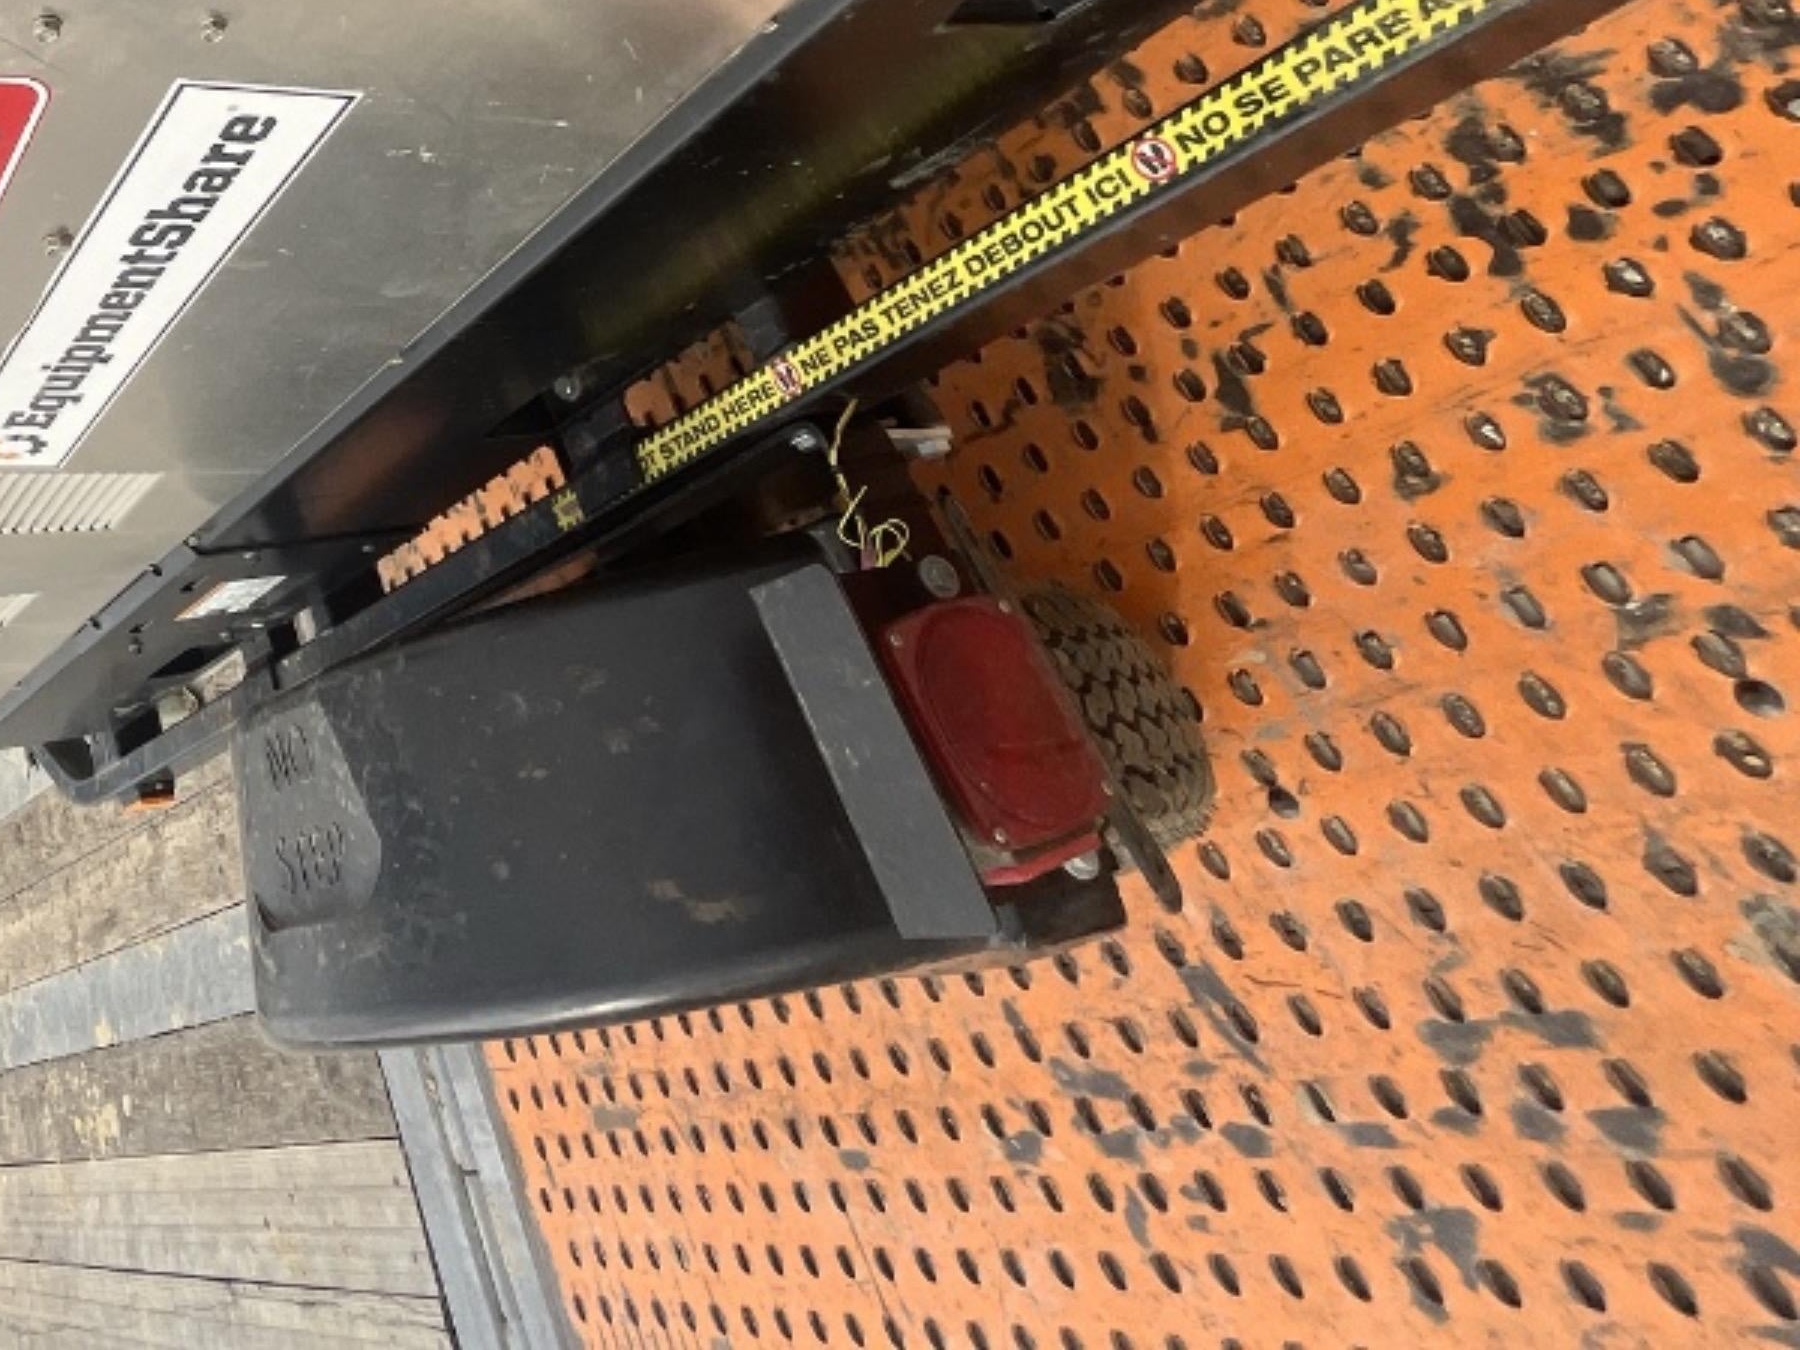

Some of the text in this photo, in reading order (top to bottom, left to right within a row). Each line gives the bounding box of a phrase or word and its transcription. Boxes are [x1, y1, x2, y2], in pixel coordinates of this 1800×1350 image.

[1174, 110, 1231, 154] NO
[1232, 74, 1292, 118] SE
[1291, 8, 1414, 88] PARE
[2, 114, 278, 430] EquipmentShare
[798, 167, 1132, 377] NE PAS TENEZ DEBOUT ICI
